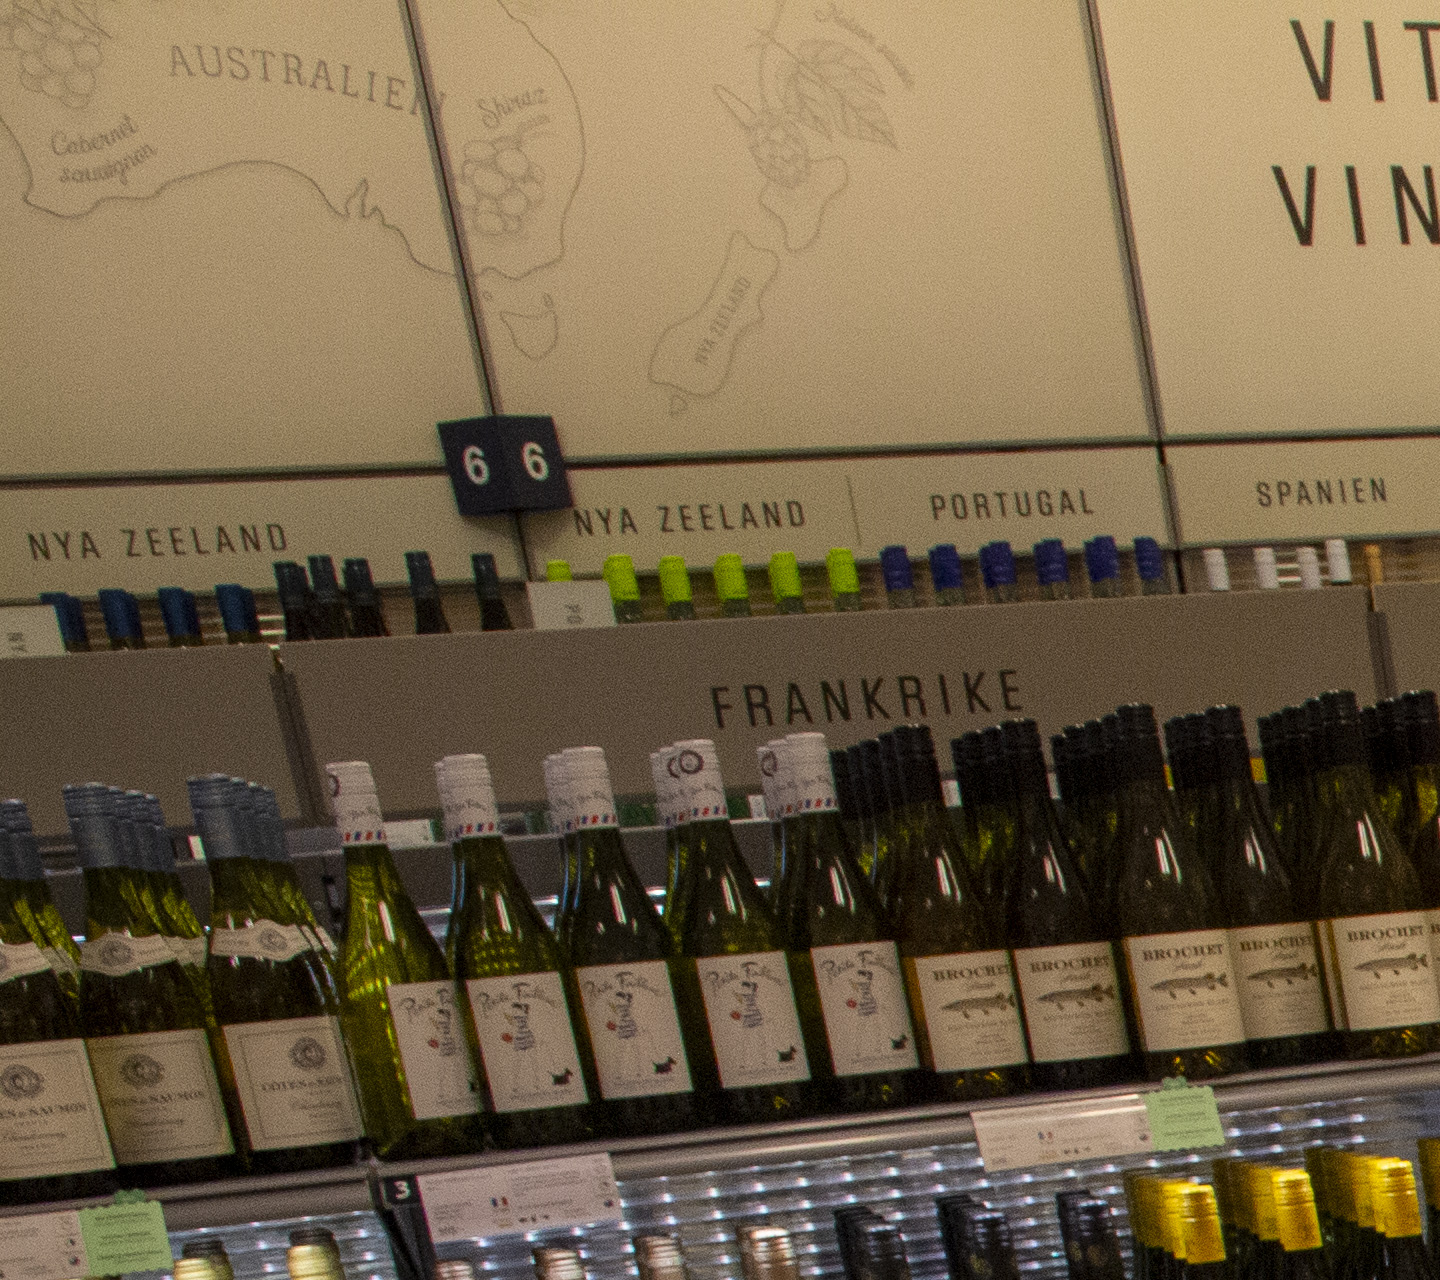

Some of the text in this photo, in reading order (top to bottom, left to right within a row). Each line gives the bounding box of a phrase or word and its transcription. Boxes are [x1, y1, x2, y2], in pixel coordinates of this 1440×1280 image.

[462, 446, 490, 486] 6
[521, 441, 549, 481] 6
[929, 487, 1095, 522] PORTUGAL
[1256, 476, 1389, 509] SPANIEN
[572, 497, 806, 538] NYA ZEELAND
[28, 521, 291, 563] NYA ZEELAND
[711, 668, 1024, 729] FRANKRIKE
[1142, 942, 1224, 963] BROCHET
[394, 1179, 411, 1200] 3
